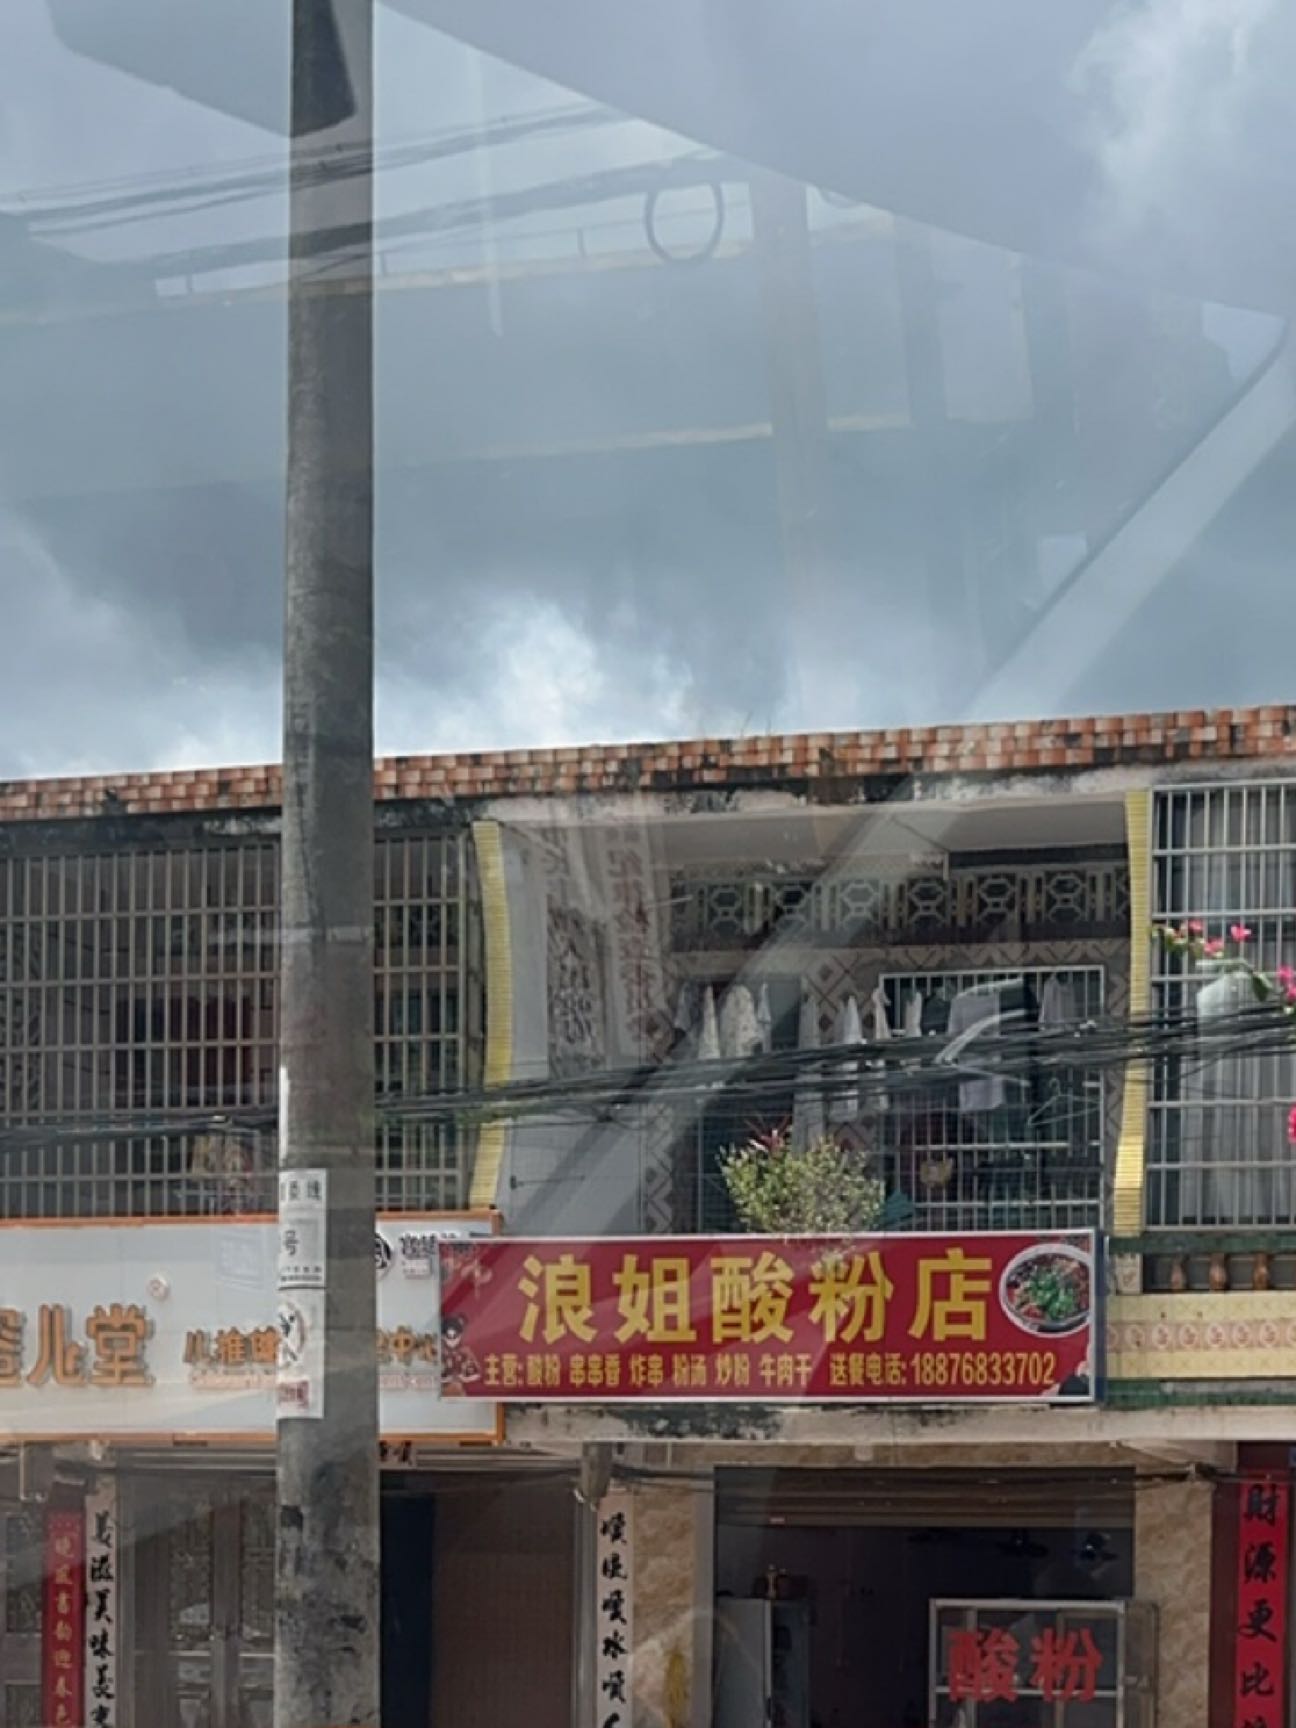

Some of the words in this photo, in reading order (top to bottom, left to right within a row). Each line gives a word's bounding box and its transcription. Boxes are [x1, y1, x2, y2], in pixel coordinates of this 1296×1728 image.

[517, 1248, 995, 1345] 浪姐酸粉店
[569, 1353, 621, 1387] 串串香
[630, 1353, 663, 1387] 炸串
[759, 1352, 812, 1387] 牛肉干
[947, 1627, 1103, 1703] 酸粉
